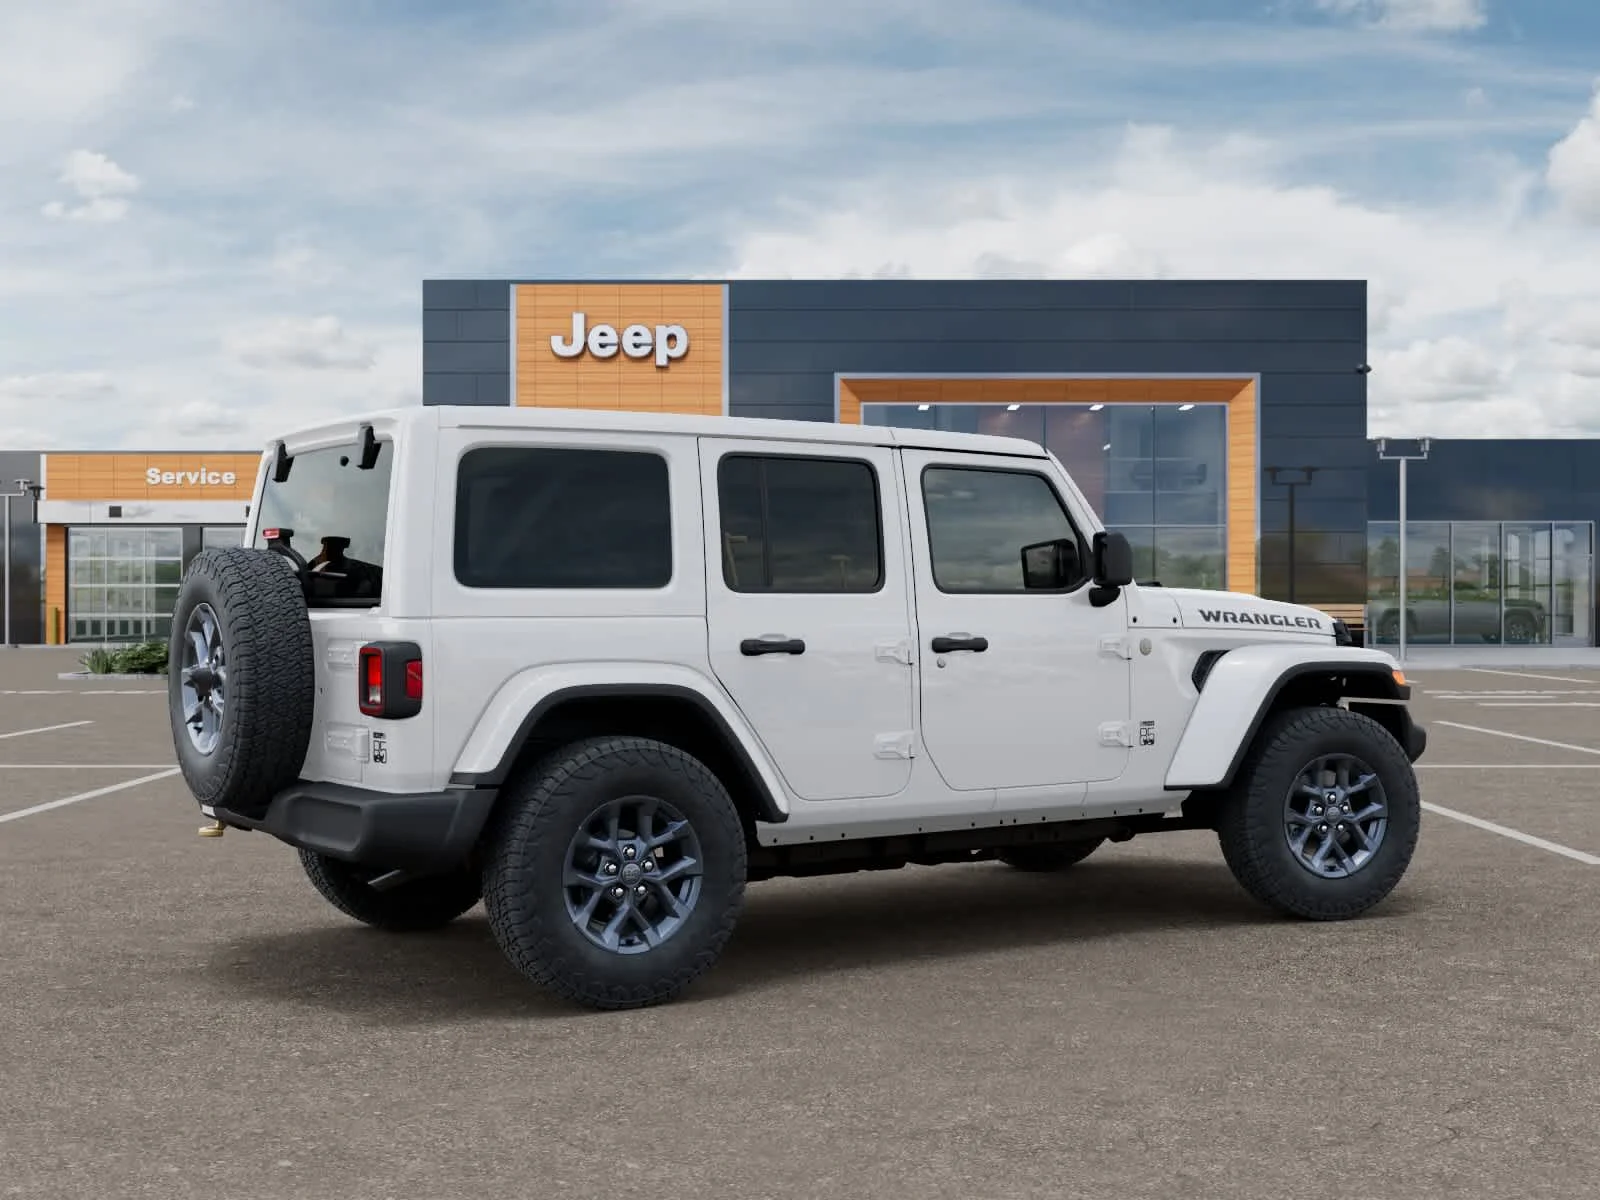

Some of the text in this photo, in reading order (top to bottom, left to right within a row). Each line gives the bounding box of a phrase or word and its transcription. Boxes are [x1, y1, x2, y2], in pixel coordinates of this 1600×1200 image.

[550, 312, 688, 366] Jeep
[146, 467, 236, 485] Service
[1199, 609, 1322, 629] WRANGLER
